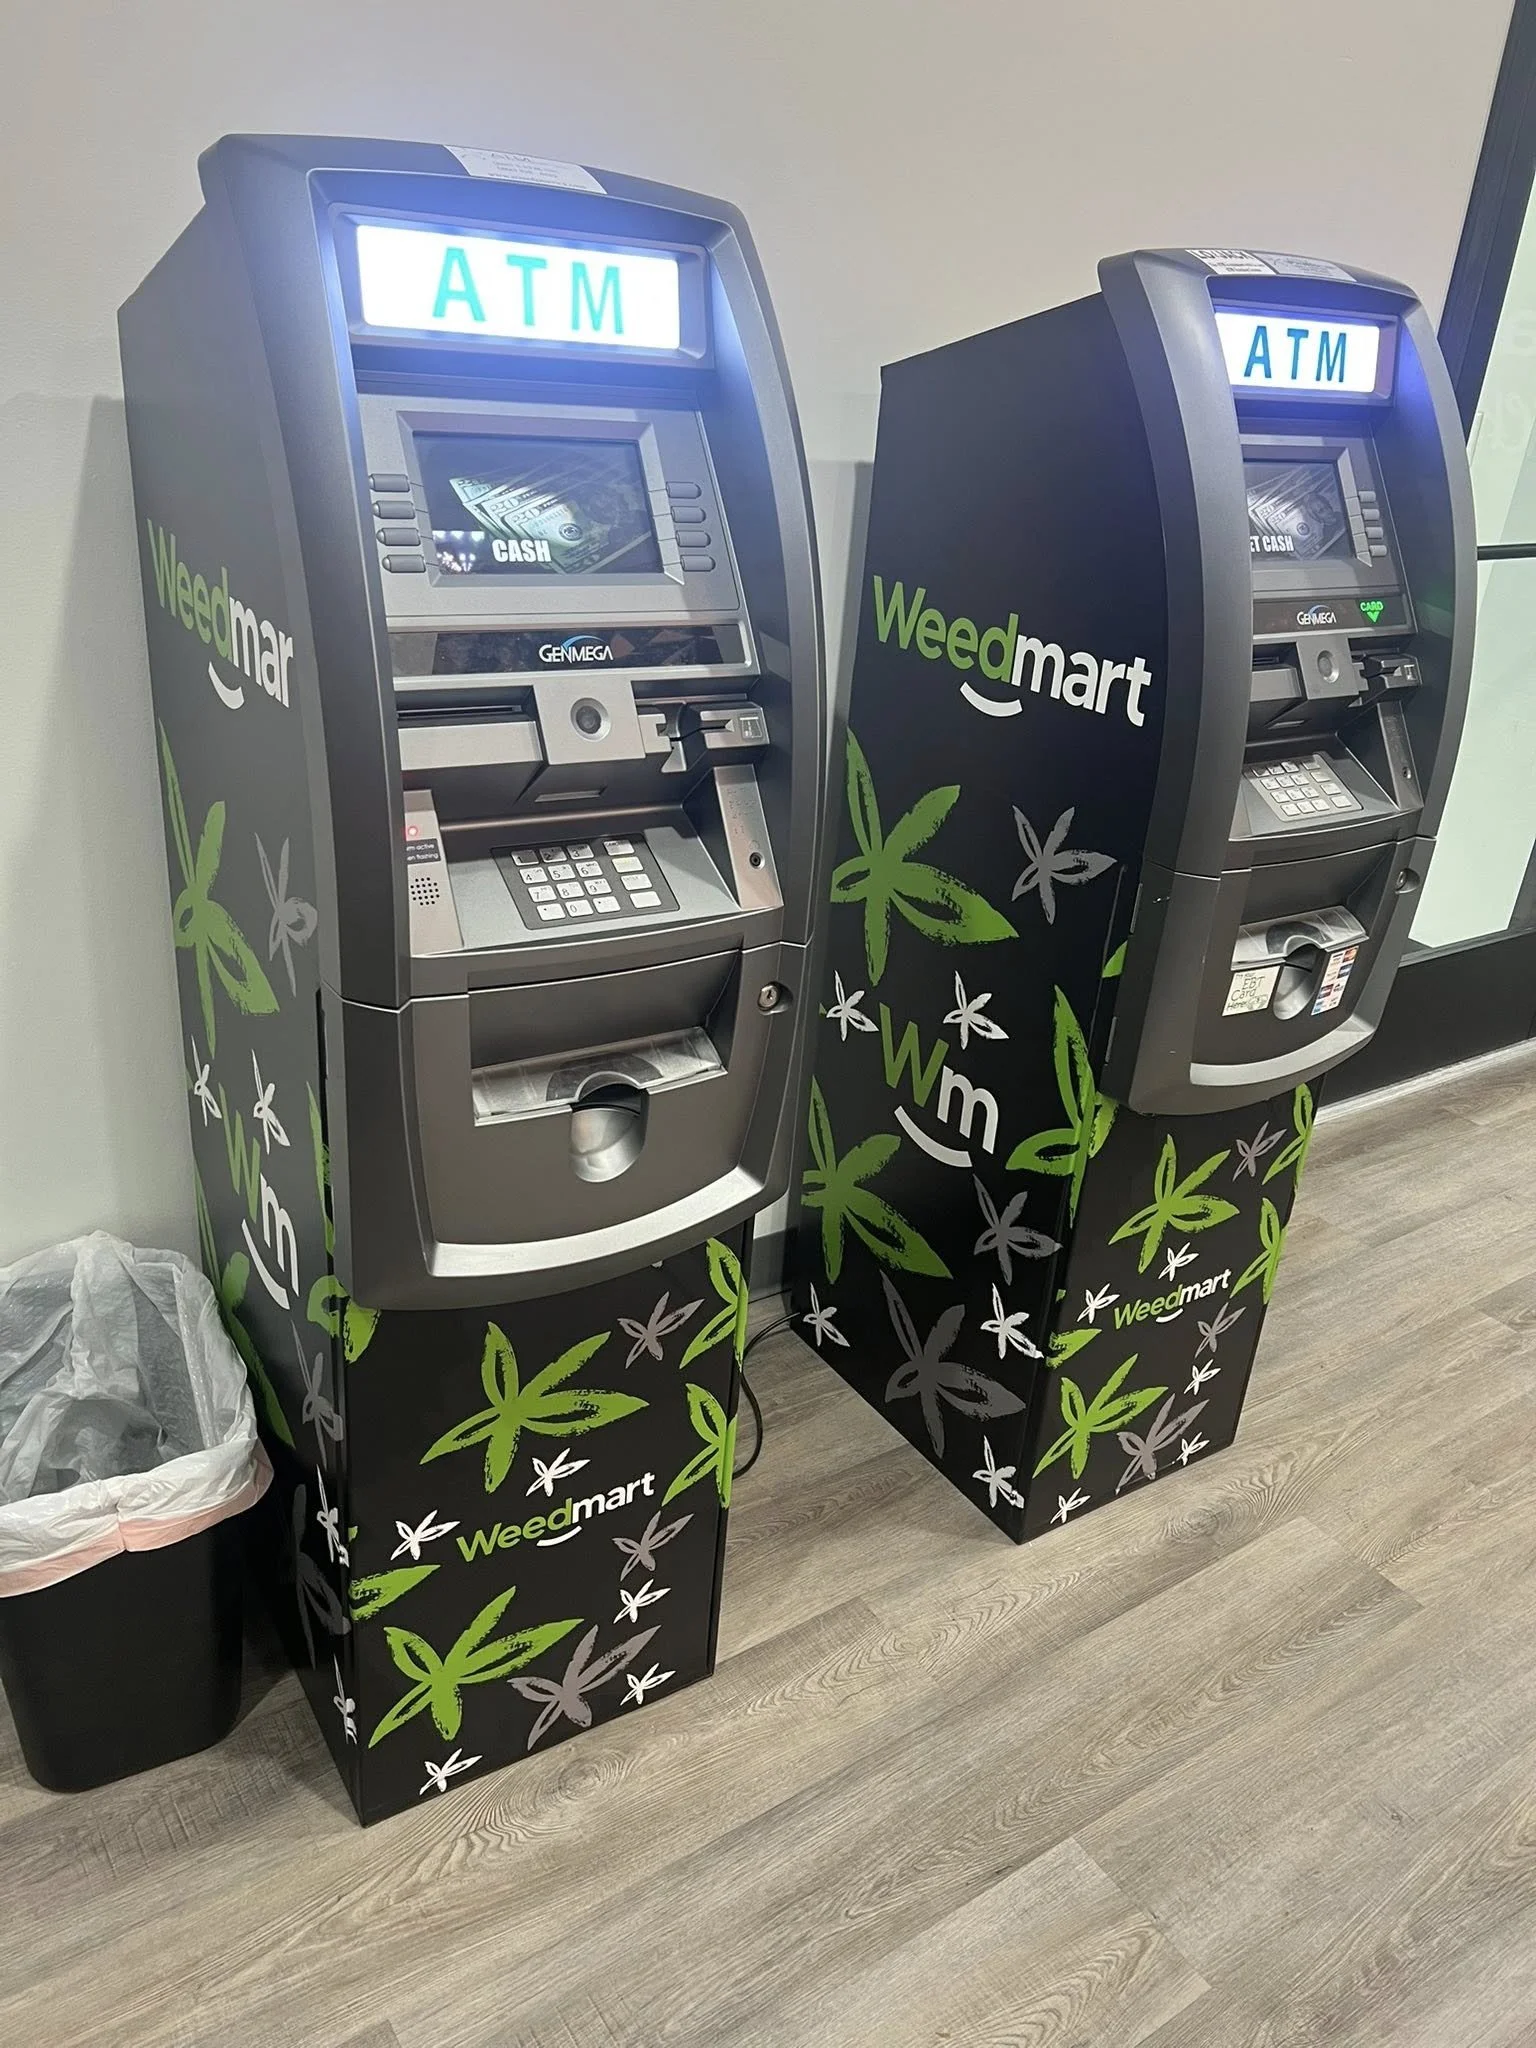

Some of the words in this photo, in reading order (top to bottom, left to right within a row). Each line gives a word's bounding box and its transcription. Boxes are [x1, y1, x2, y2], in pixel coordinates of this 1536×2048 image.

[433, 247, 623, 334] ATM
[1244, 325, 1347, 382] ATM
[492, 539, 552, 562] CASH
[1249, 535, 1261, 553] ET
[1262, 535, 1295, 553] CASH
[1360, 602, 1383, 611] CARD
[1297, 611, 1337, 626] GENMEGA
[538, 644, 613, 663] GENMEGA
[873, 575, 1152, 727] Weedmart
[573, 849, 580, 857] 3
[552, 870, 560, 878] 5
[581, 867, 589, 875] 6
[534, 891, 540, 900] 7
[561, 888, 570, 896] 8
[589, 884, 597, 893] 9
[569, 904, 577, 913] 0
[1114, 1269, 1231, 1330] Weedmart
[456, 1472, 655, 1562] Weedmart
